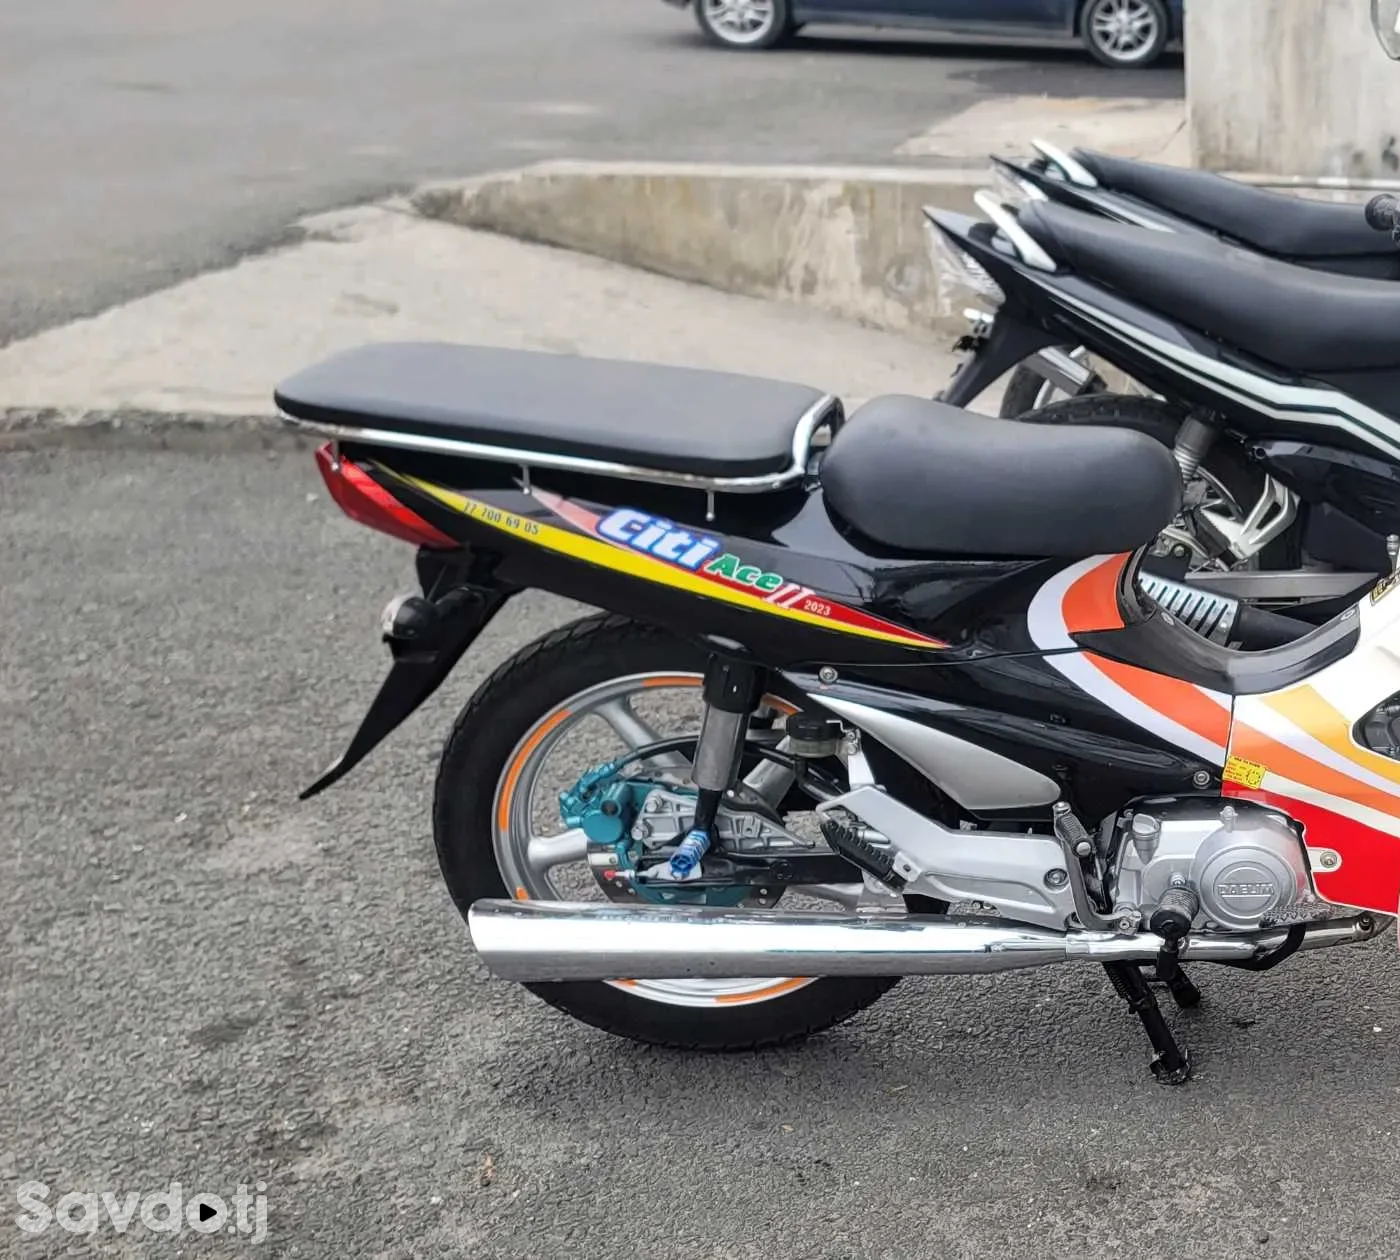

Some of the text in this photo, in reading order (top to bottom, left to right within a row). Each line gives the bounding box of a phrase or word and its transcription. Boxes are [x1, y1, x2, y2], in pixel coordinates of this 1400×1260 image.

[600, 508, 721, 570] Citi
[704, 553, 783, 592] Ace
[803, 599, 832, 616] 2023
